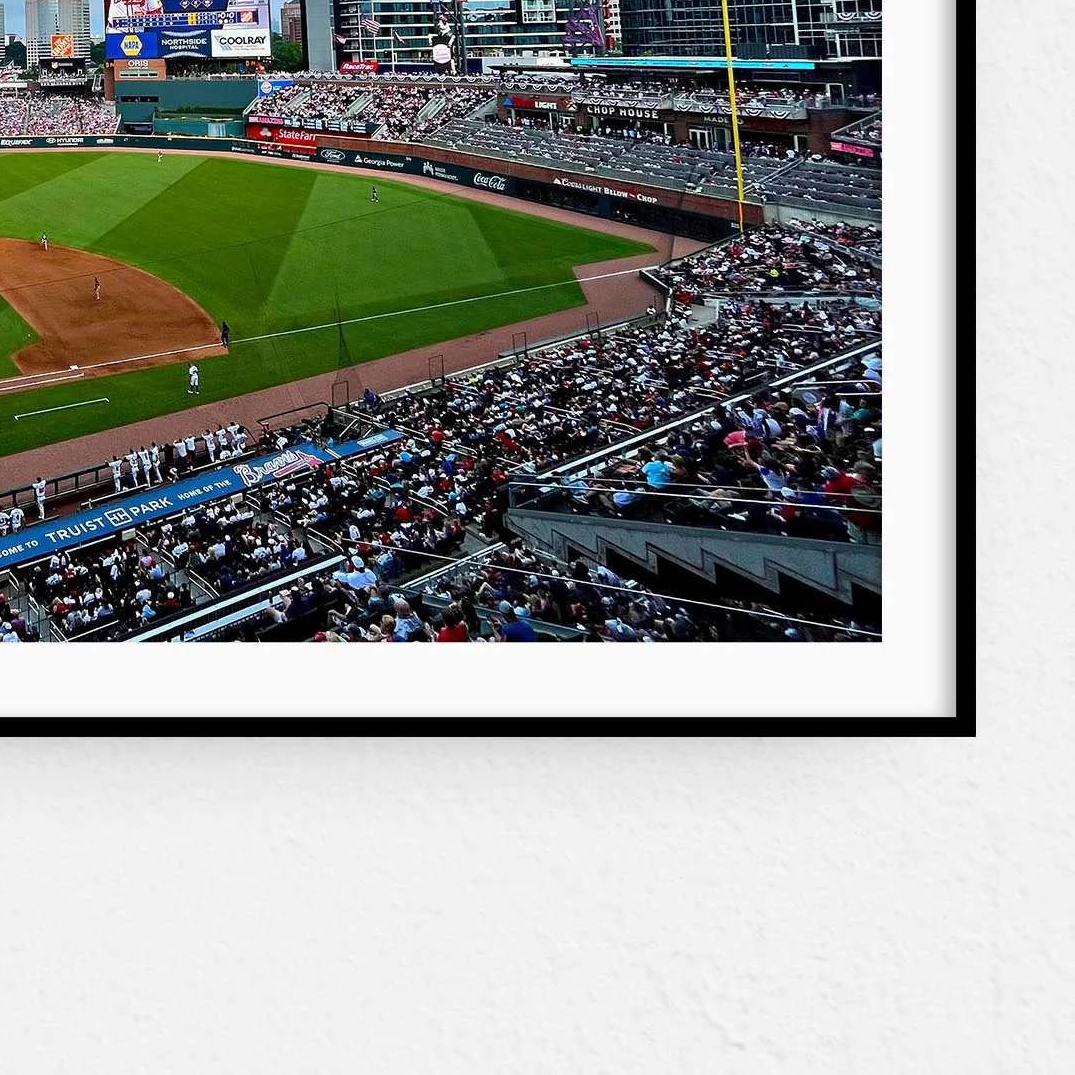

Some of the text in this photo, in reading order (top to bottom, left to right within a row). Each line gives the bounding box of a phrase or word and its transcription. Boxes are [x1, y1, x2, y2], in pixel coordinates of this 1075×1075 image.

[124, 41, 139, 49] NAPA
[220, 35, 267, 45] COOLRAY
[342, 63, 374, 71] RaceTrac
[534, 101, 557, 110] LIGHT
[587, 105, 659, 119] CHOP HOUSE
[703, 116, 730, 124] MADE
[363, 157, 405, 168] Georgia Power
[583, 184, 602, 193] LIGHT
[603, 187, 628, 198] BELOW
[636, 193, 658, 204] CHOP
[24, 540, 39, 550] TO
[45, 517, 105, 544] TRUIST
[128, 496, 174, 517] PARK
[177, 488, 201, 502] HOME
[202, 484, 214, 493] OF
[215, 479, 232, 490] THE
[233, 449, 300, 487] Braves
